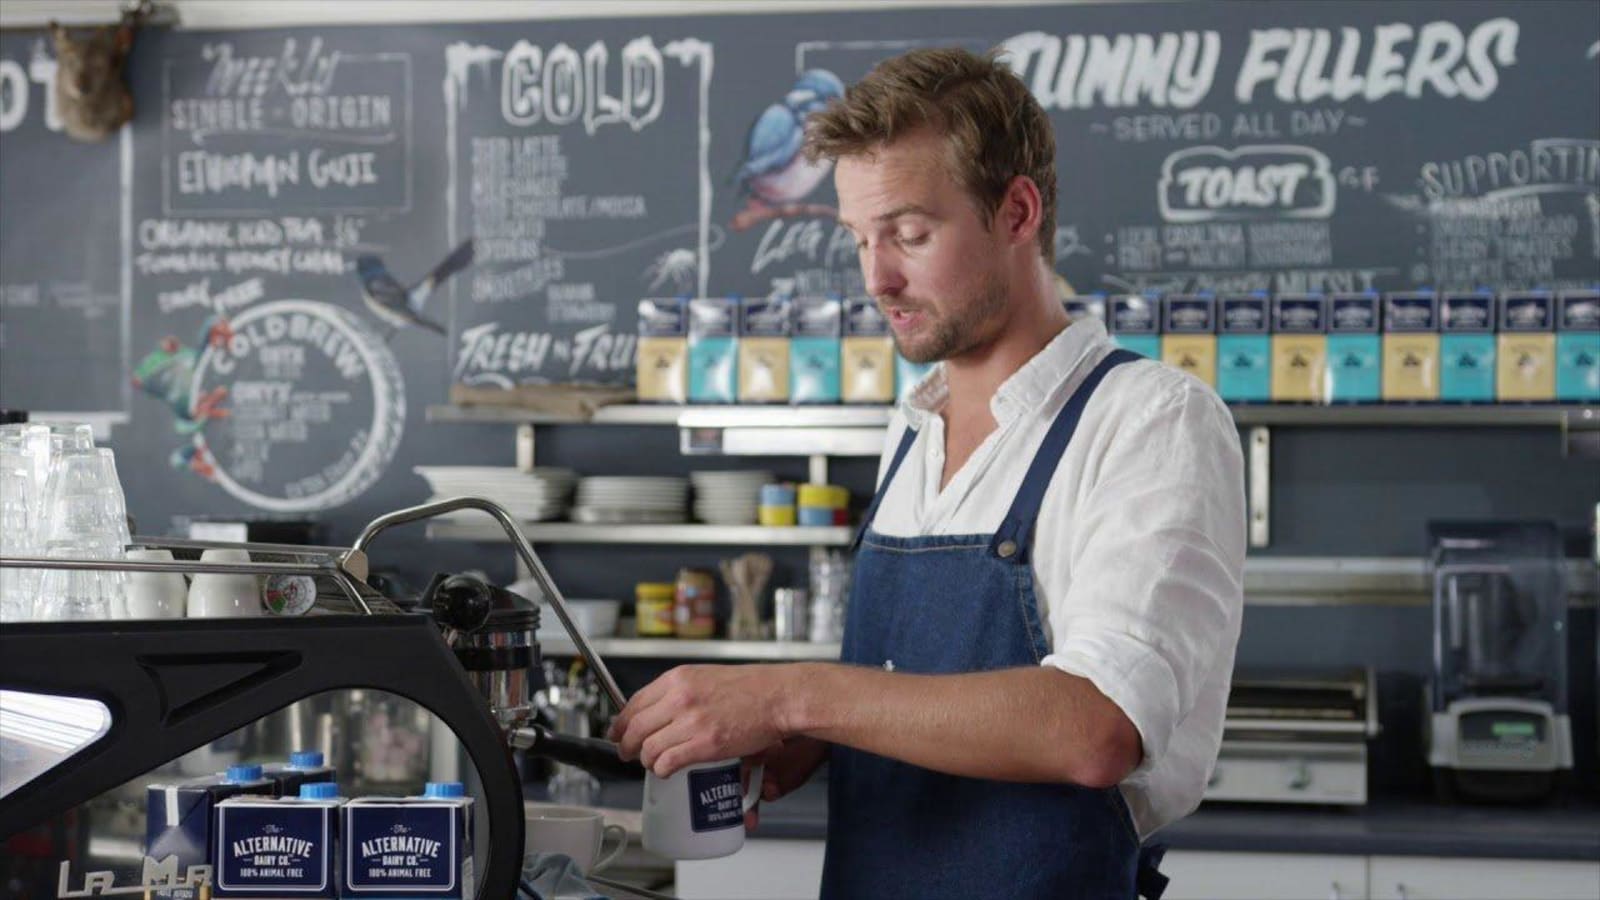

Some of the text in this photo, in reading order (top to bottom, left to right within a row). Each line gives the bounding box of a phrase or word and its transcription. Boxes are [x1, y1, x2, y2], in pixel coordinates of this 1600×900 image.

[1000, 18, 1519, 109] TUMMY FILLERS
[502, 36, 664, 136] COLD
[291, 95, 391, 128] ORIGIN
[1112, 108, 1345, 141] SERVED ALL DAY
[1177, 161, 1308, 209] TOAST
[453, 322, 552, 378] FRESH
[233, 836, 313, 859] ALTERNATIVE
[254, 855, 276, 866] DAIRY
[361, 836, 441, 859] ALTERNATIVE
[382, 855, 404, 866] DAIRY
[240, 868, 303, 878] 100% ANIMAL FREE
[368, 868, 431, 878] 100% ANIMAL FREE
